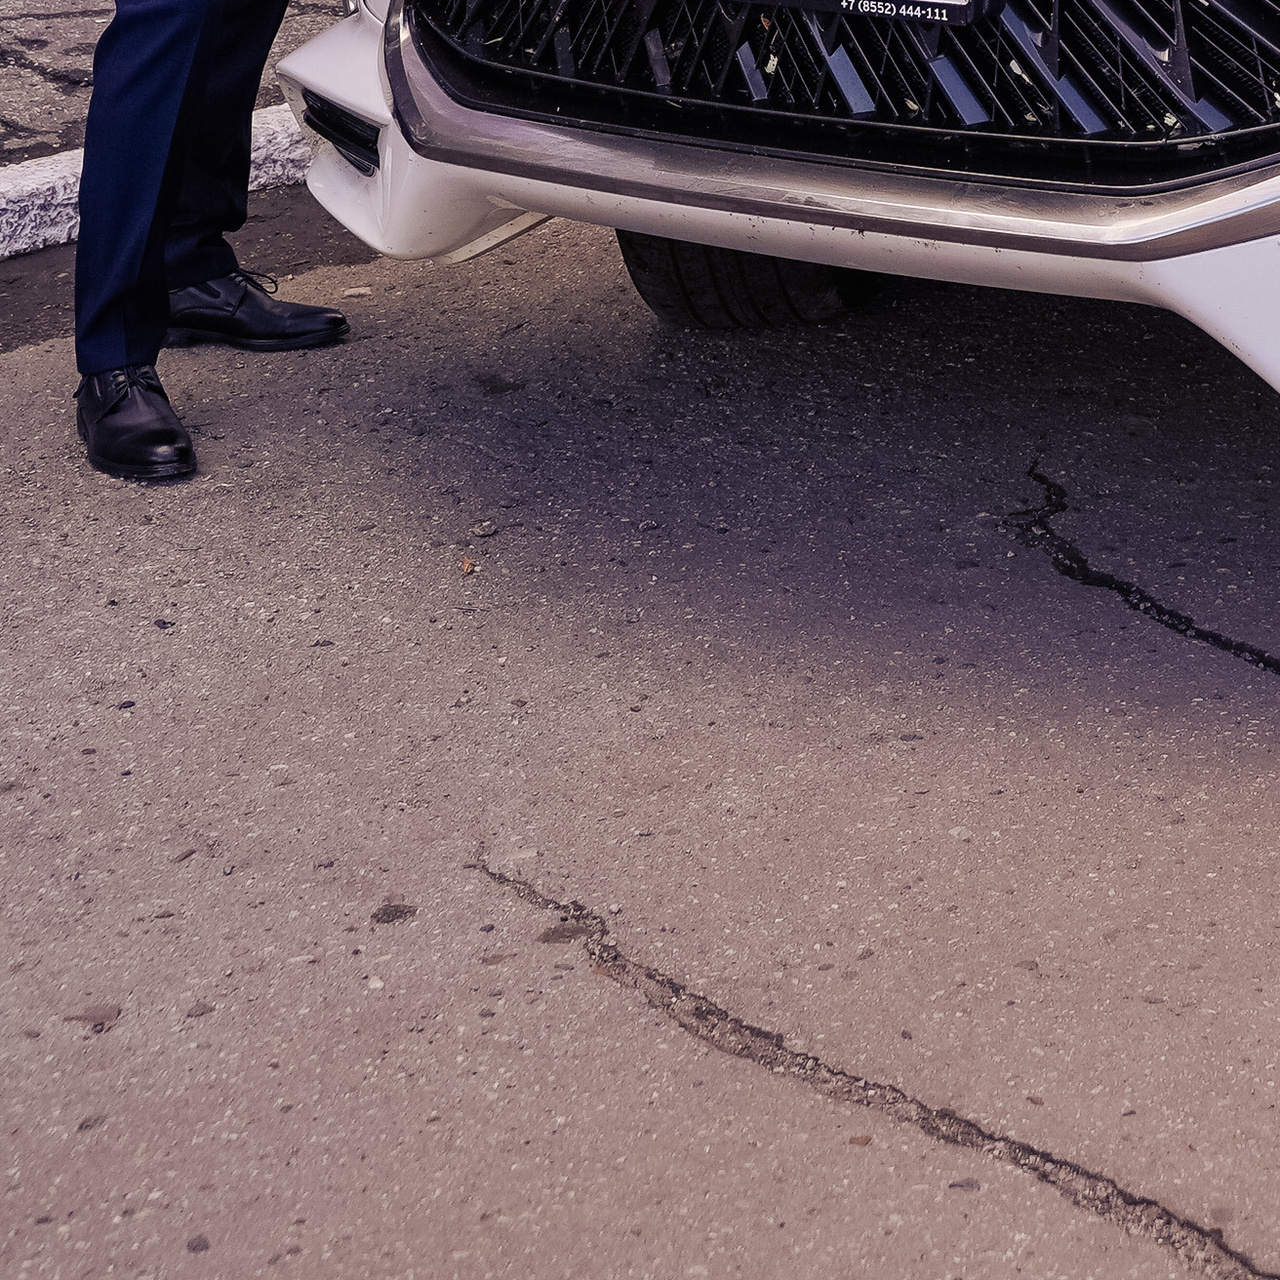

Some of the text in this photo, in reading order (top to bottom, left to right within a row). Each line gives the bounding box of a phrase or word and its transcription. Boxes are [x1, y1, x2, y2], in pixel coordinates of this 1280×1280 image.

[841, 0, 949, 22] +7 (8552) 444-111
